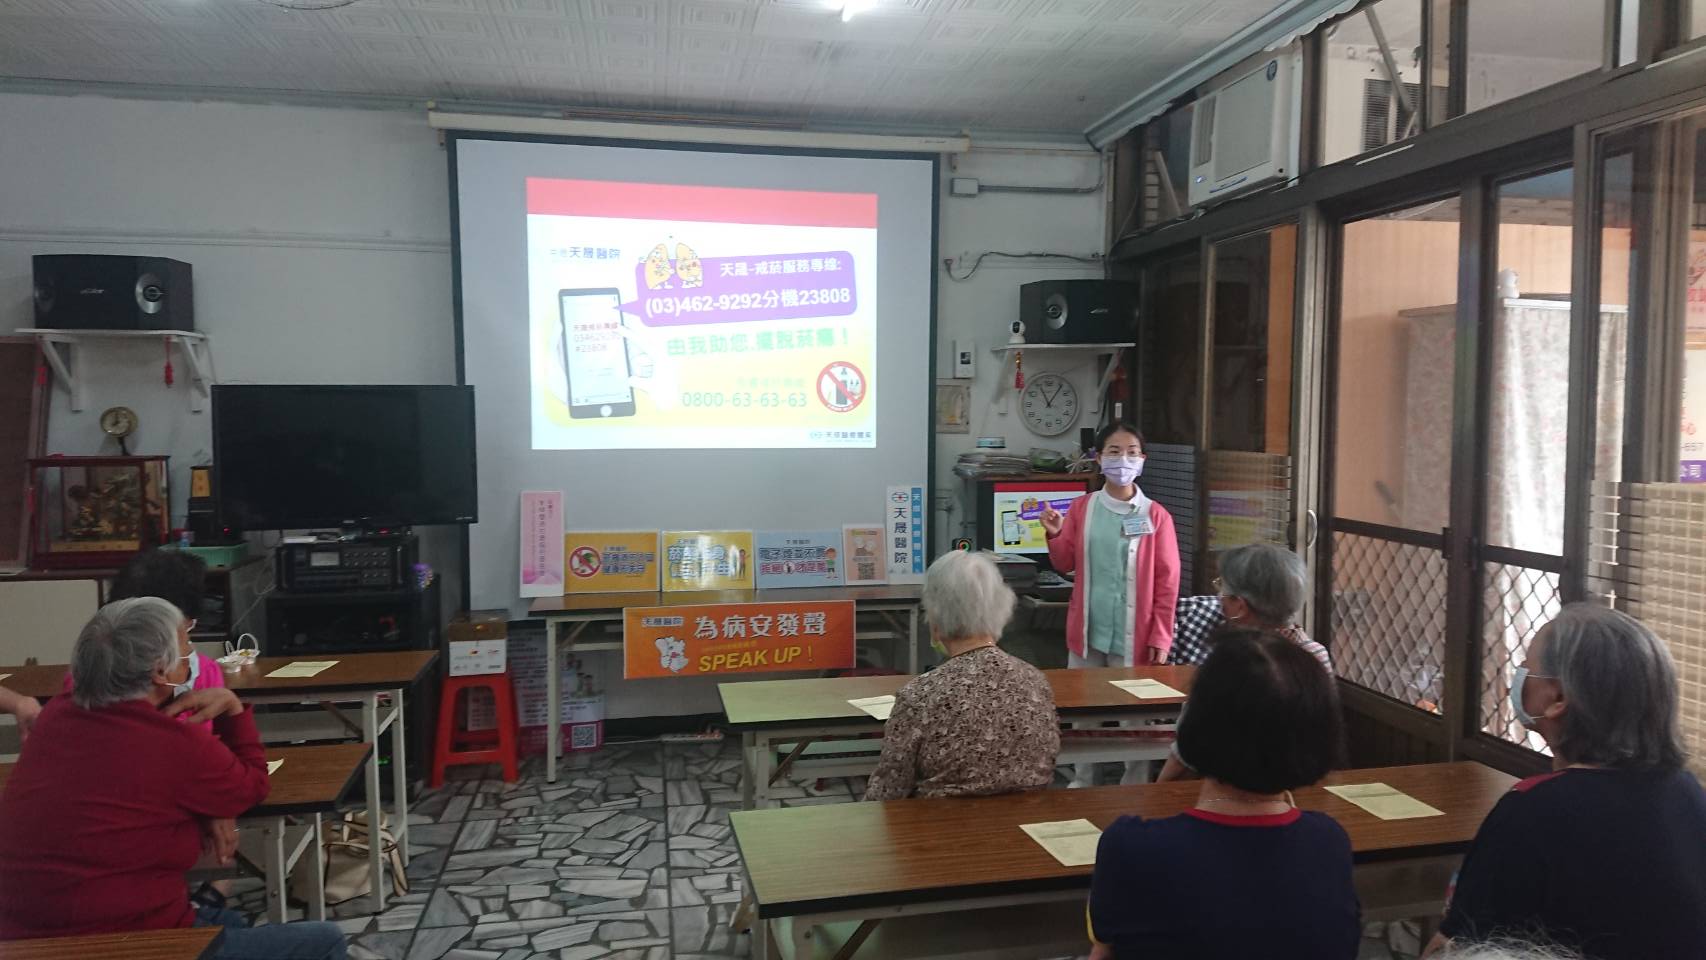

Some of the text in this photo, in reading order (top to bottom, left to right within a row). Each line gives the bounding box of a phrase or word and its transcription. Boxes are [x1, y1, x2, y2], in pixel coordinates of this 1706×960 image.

[681, 391, 808, 408] 0800-63-63-63
[893, 507, 908, 564] 天晟醫院
[693, 611, 827, 640] 為病安發聲
[698, 648, 768, 673] SPEAK
